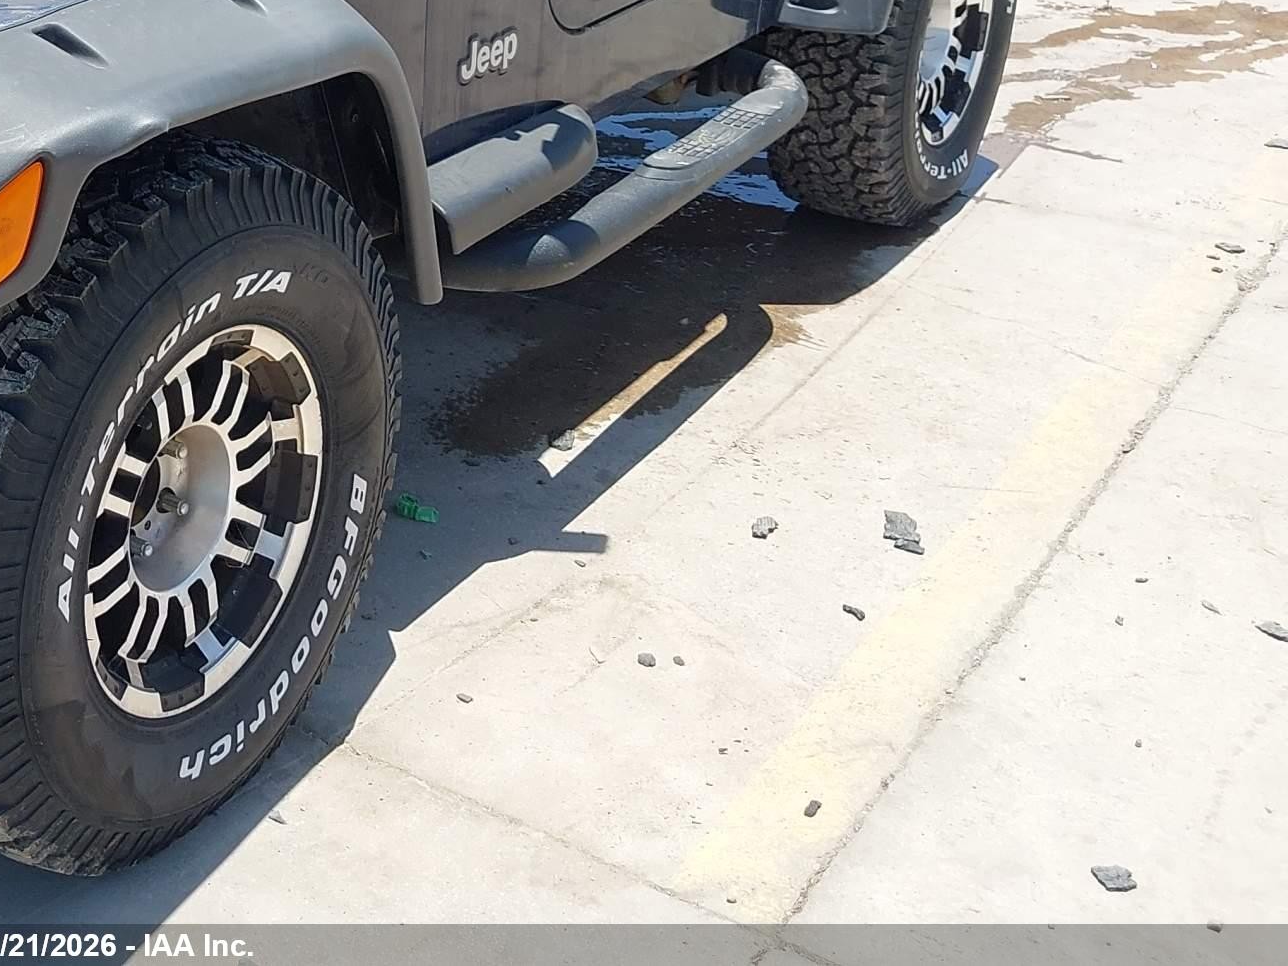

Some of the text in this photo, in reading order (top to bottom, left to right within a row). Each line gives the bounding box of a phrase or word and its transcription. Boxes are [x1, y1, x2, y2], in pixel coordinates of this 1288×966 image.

[461, 33, 518, 80] Jeep
[57, 292, 221, 623] All-Terrain
[233, 269, 292, 300] T/A
[179, 473, 368, 781] BFGoodrich
